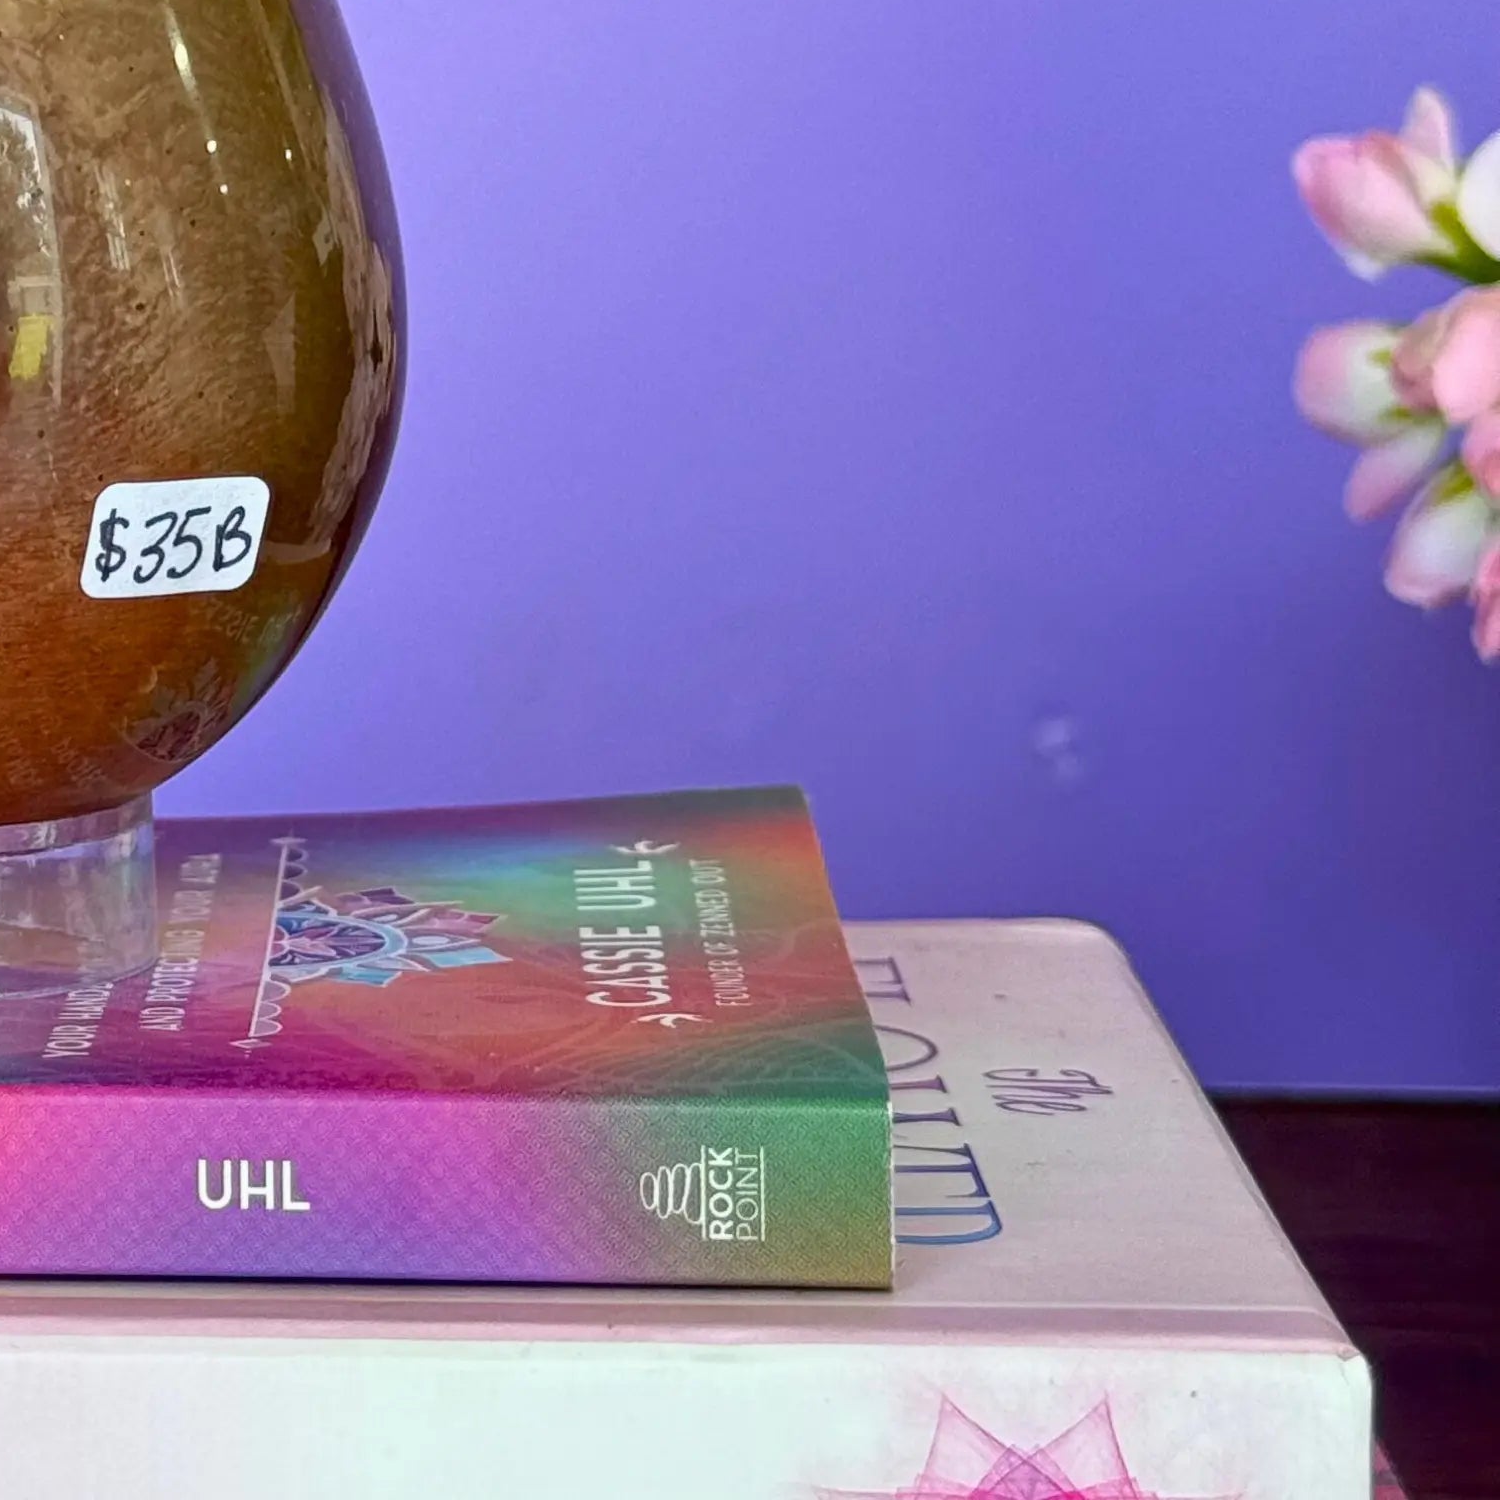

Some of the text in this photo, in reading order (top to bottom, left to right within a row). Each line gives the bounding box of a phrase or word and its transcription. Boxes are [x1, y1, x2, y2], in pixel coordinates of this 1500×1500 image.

[168, 890, 215, 924] YOUR
[573, 860, 673, 1008] CASSIE UHL
[688, 859, 754, 1007] FOUNDER OF ZENNED OUT
[144, 929, 205, 1003] PROTECTING
[42, 1024, 98, 1058] YOUR
[140, 1006, 186, 1031] AND
[982, 1068, 1114, 1116] The
[197, 1158, 311, 1212] UHL
[708, 1147, 734, 1240] ROCK
[736, 1147, 759, 1240] POINT
